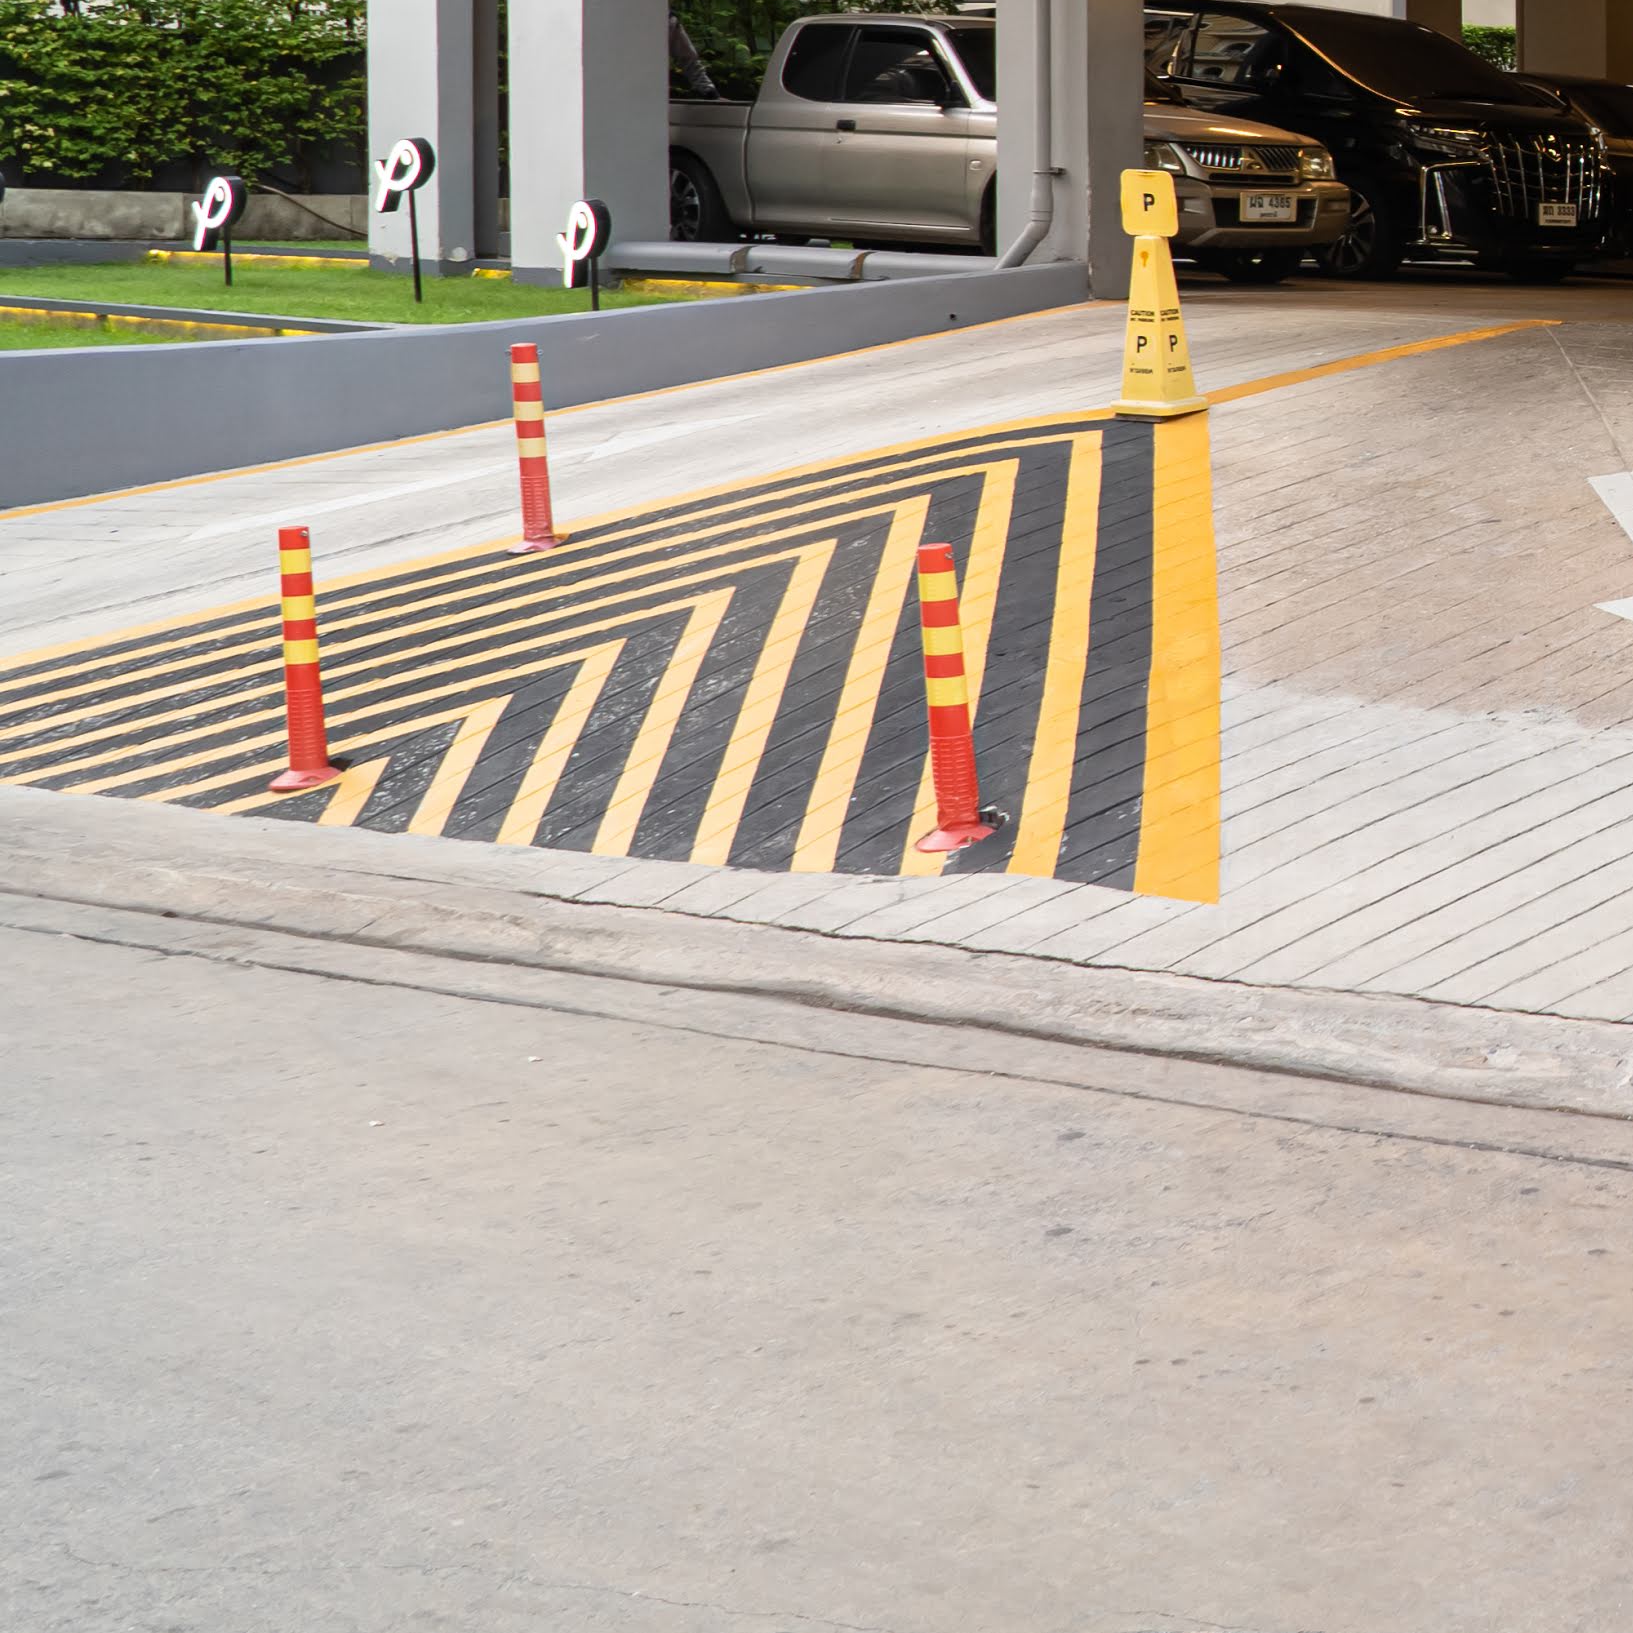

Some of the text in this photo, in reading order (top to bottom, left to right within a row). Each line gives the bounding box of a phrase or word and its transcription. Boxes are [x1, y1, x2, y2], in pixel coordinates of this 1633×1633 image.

[1143, 193, 1155, 211] P
[1136, 335, 1148, 354] P
[1168, 334, 1178, 353] P
